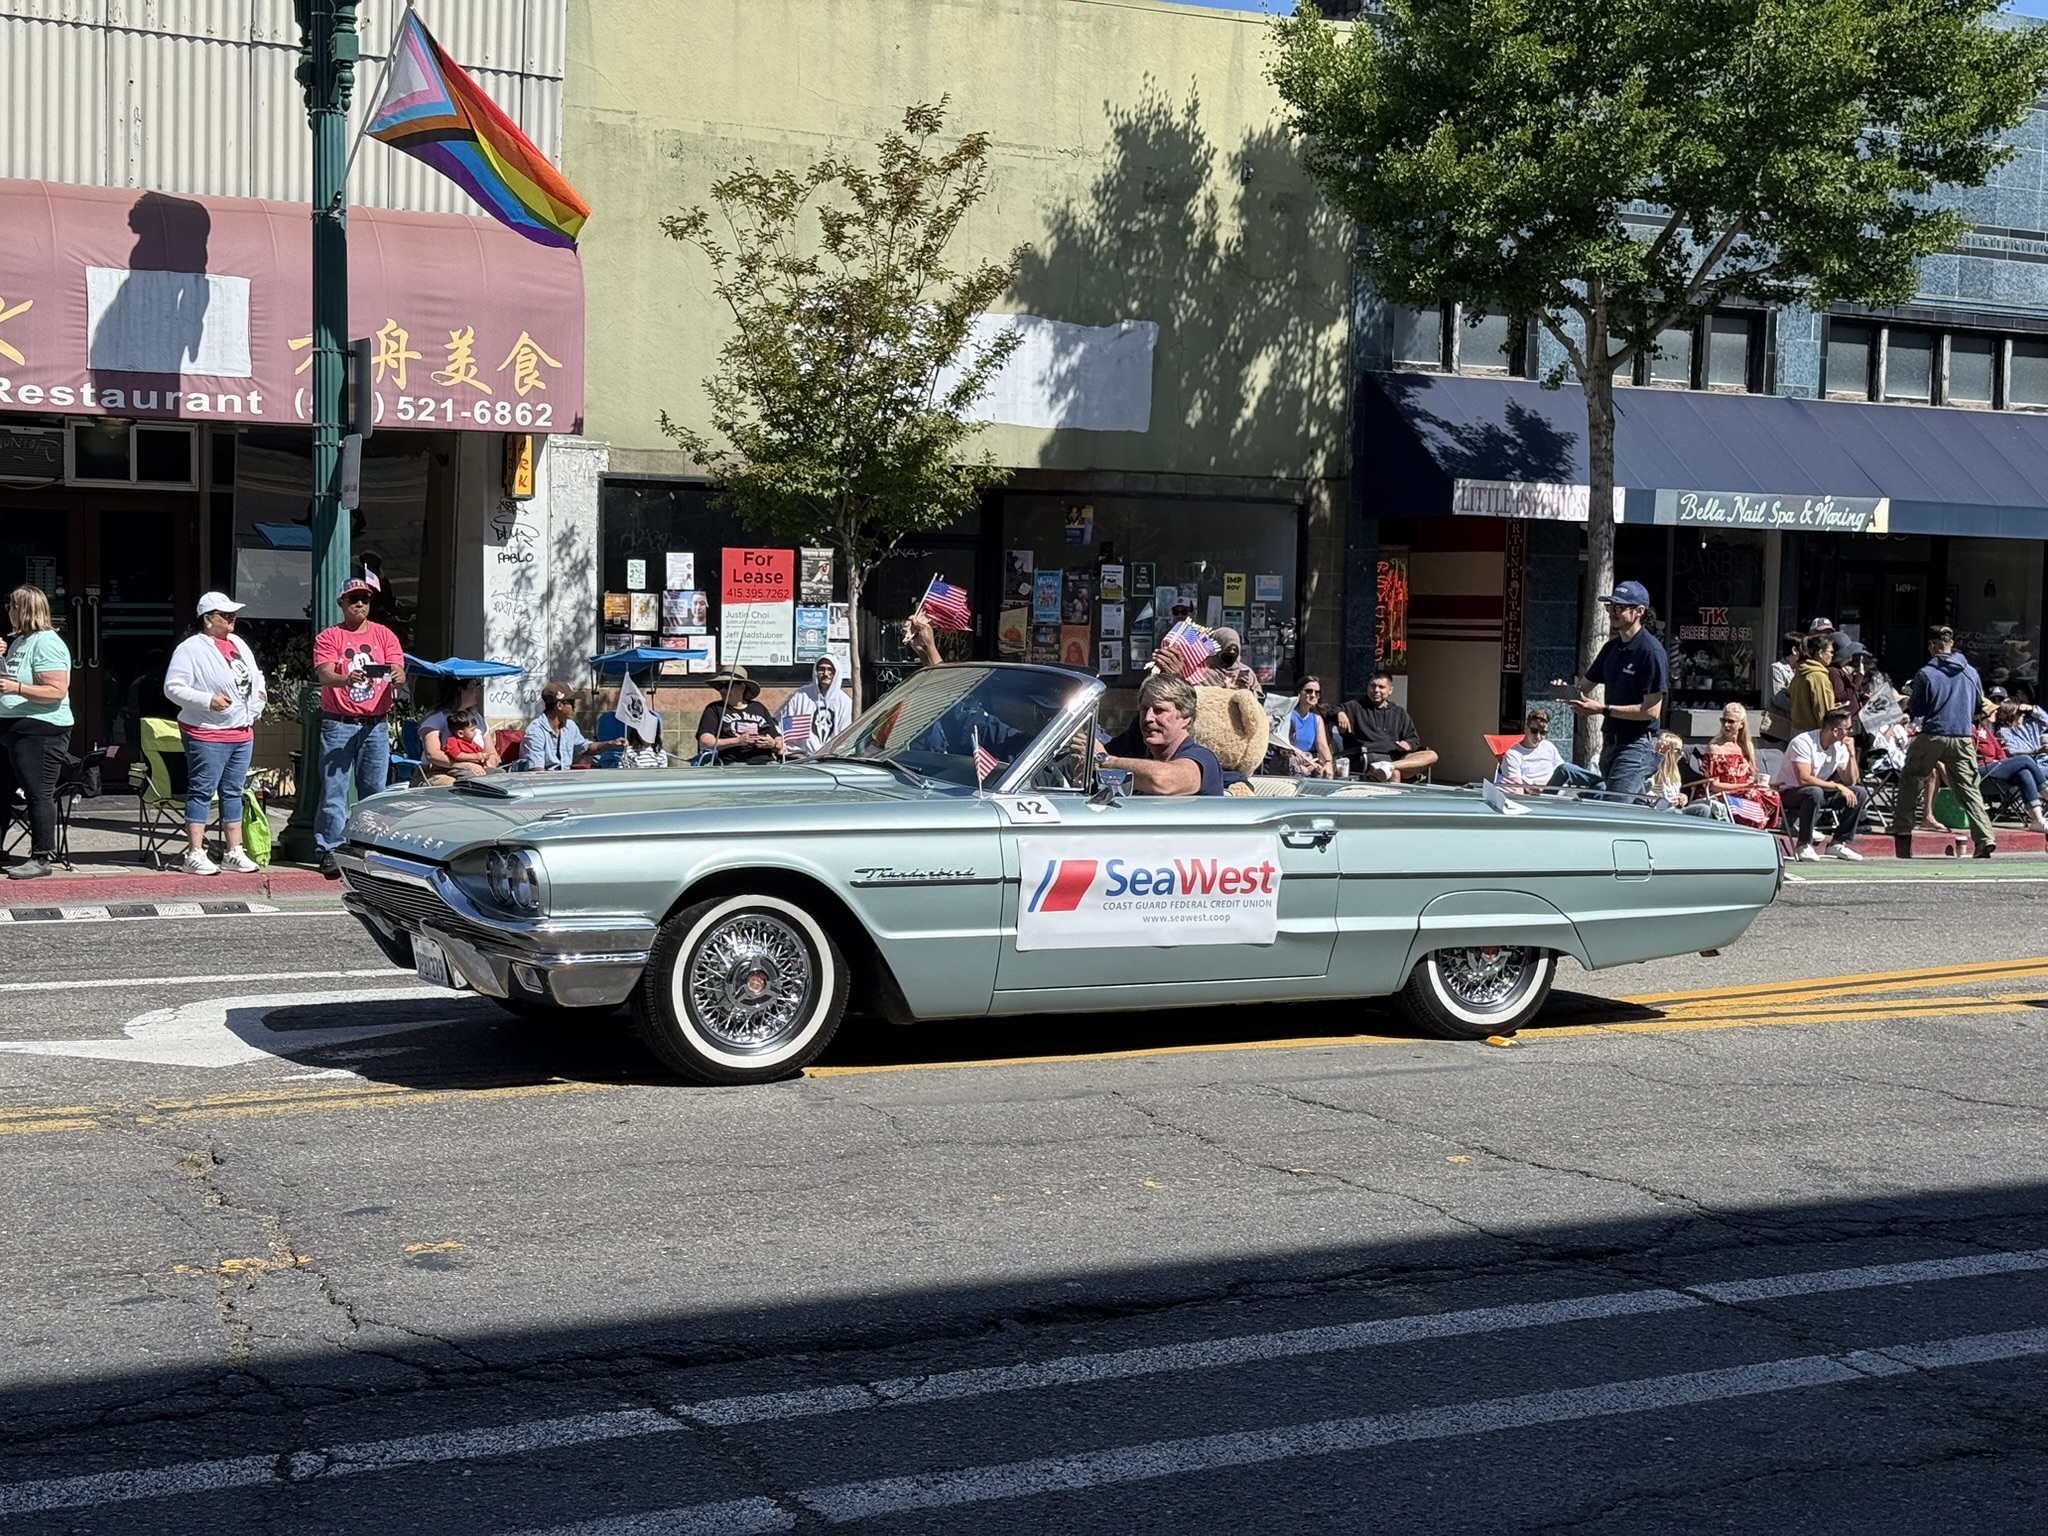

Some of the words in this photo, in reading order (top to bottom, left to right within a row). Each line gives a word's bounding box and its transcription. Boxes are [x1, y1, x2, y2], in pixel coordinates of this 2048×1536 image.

[0, 377, 263, 415] Restaurant
[396, 396, 553, 427] 521-6862
[1460, 485, 1512, 514] LITTLE
[1680, 493, 1726, 522] Bella
[1727, 495, 1765, 523] Nail
[1768, 500, 1796, 529] Spa
[1800, 499, 1812, 526] &
[1814, 501, 1867, 532] Waxing
[743, 551, 774, 567] For
[732, 568, 784, 584] Lease
[1226, 576, 1243, 584] IMP
[726, 588, 790, 599] 415.395.7262
[725, 611, 749, 619] Justin
[751, 611, 770, 619] Choi
[1698, 606, 1729, 625] TK
[724, 631, 740, 639] Jeff
[1507, 601, 1519, 663] TELLER
[1679, 625, 1709, 640] BARBER
[1710, 626, 1730, 641] SHOP
[1738, 627, 1753, 641] SPA
[779, 655, 791, 663] JLL
[722, 712, 742, 724] OLD
[742, 711, 767, 728] NAVY
[1016, 801, 1049, 815] 42
[854, 867, 976, 879] Thunderbird
[1104, 858, 1276, 897] SeaWest
[1102, 902, 1133, 911] COAST
[1135, 901, 1168, 910] GUARD
[1169, 900, 1208, 909] FEDERAL
[1210, 899, 1241, 909] CREDIT
[1242, 899, 1272, 908] UNION
[1142, 913, 1231, 923] www.seawest.coop
